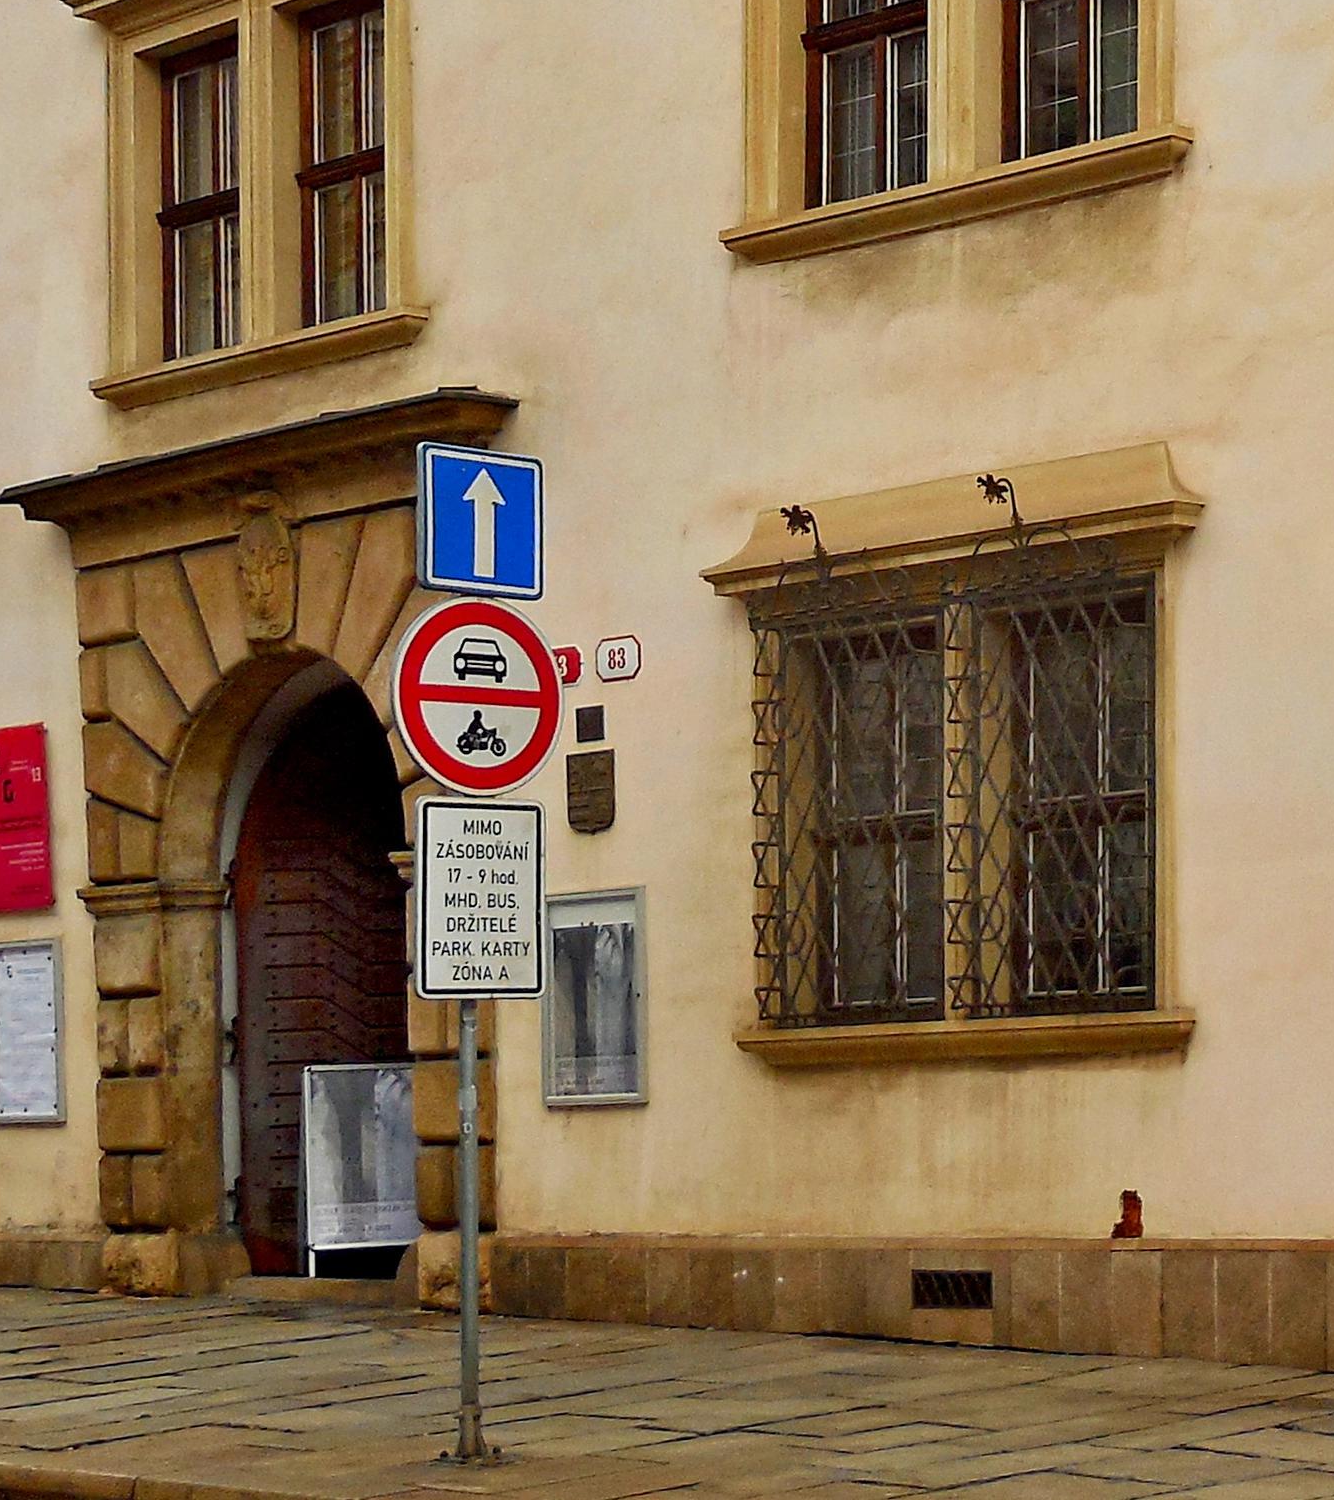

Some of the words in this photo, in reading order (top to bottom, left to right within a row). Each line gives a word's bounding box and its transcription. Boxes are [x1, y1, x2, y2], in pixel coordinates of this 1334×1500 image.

[608, 647, 626, 670] 83
[463, 819, 502, 836] MIMO
[436, 839, 530, 861] ZÁSOBOVÁNÍ
[447, 868, 461, 884] 17
[478, 868, 487, 884] 9
[491, 869, 519, 885] hod.
[444, 892, 482, 909] MHD.
[487, 893, 520, 909] BUS.
[446, 913, 517, 933] DRŽITELÉ
[432, 941, 475, 957] PARK.
[481, 941, 531, 957] KARTY
[452, 961, 493, 981] ZÓNA
[498, 965, 509, 981] A
